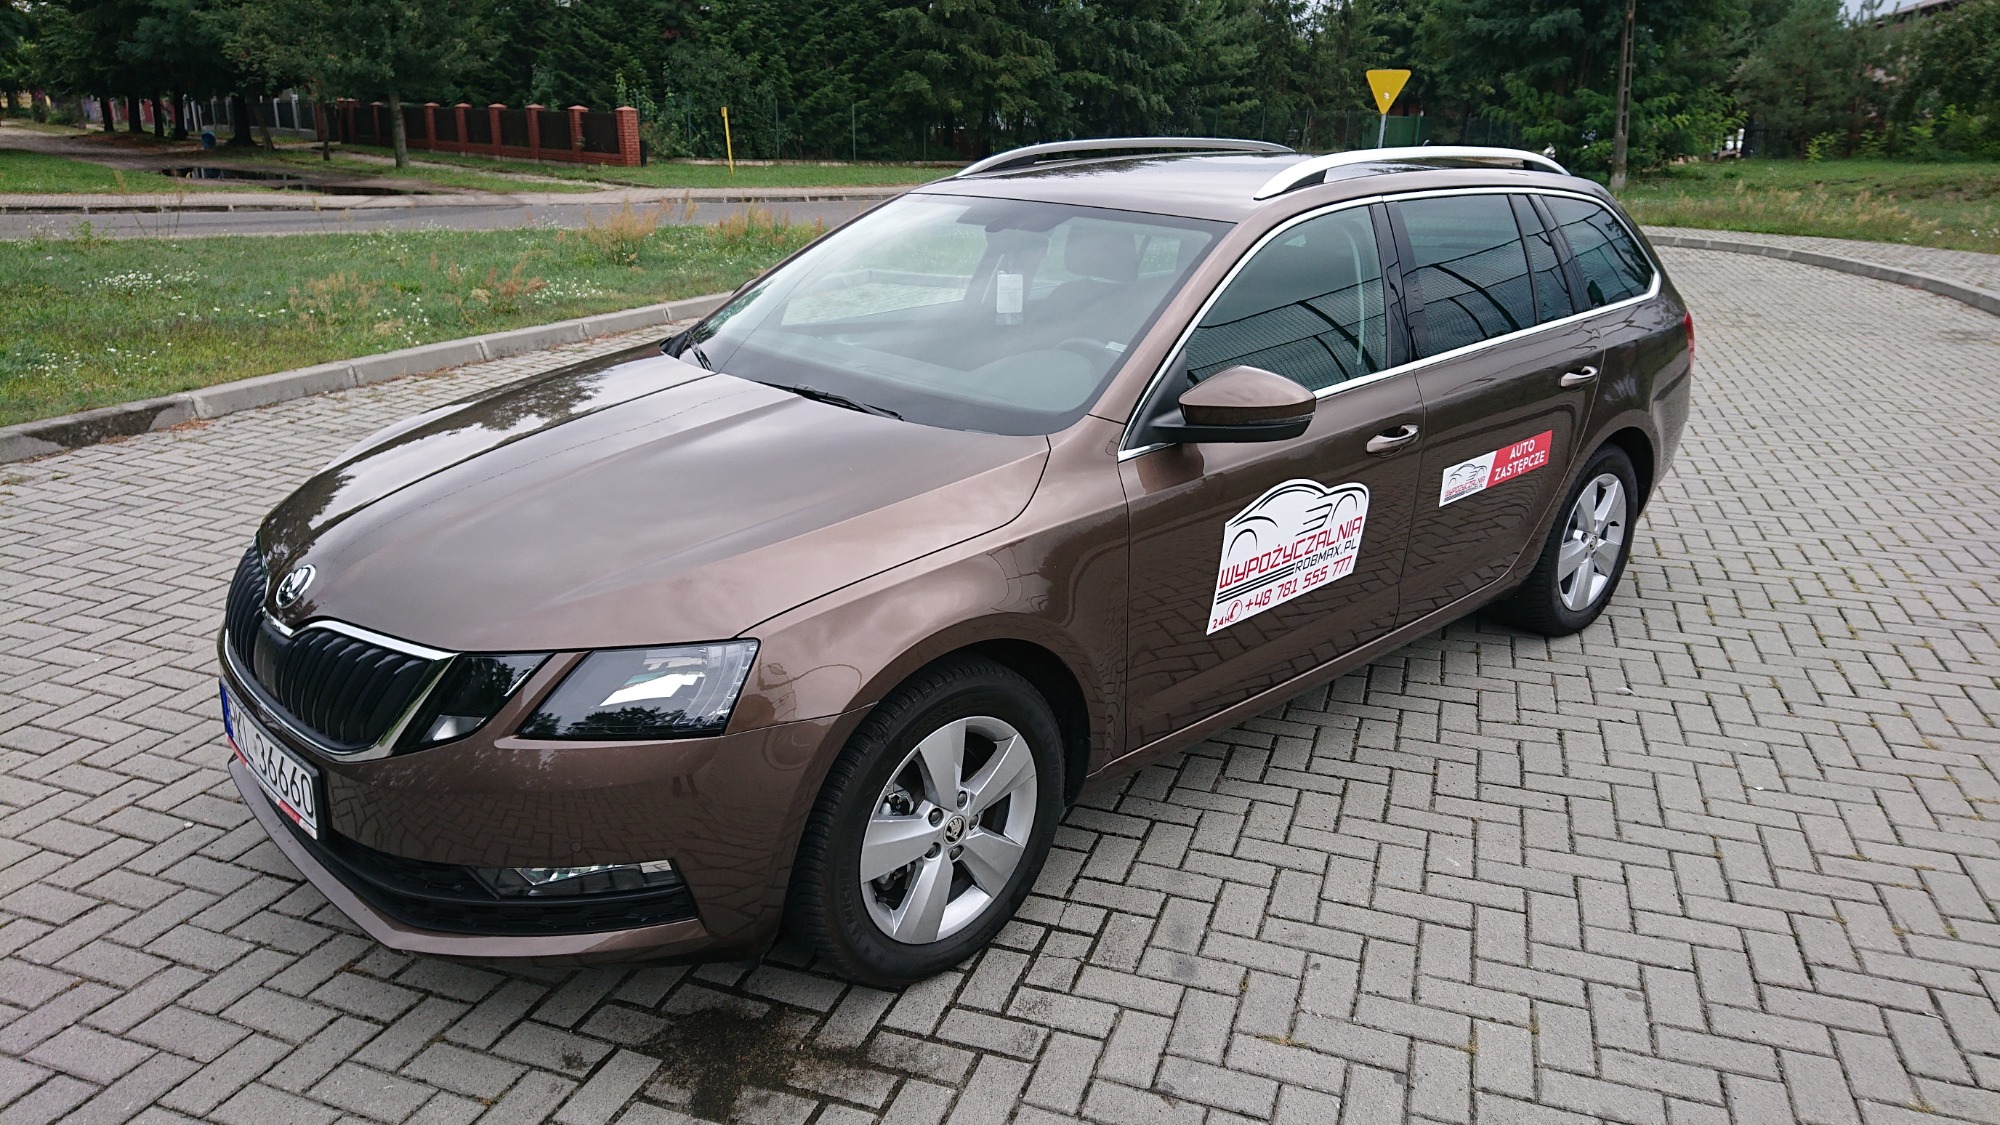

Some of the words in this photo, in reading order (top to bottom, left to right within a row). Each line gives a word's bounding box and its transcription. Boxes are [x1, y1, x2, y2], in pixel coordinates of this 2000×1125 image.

[1494, 450, 1546, 481] ZASTĘPCZE
[1509, 439, 1535, 459] AUTO
[1219, 516, 1363, 589] WYPOŻYCZALNIA
[1294, 538, 1357, 573] ROBMAX.PL
[1212, 615, 1230, 629] 24H
[1245, 589, 1272, 611] +48
[1277, 578, 1298, 600] 781
[1302, 565, 1328, 589] 555
[1332, 555, 1352, 576] 777
[256, 733, 314, 819] 36660
